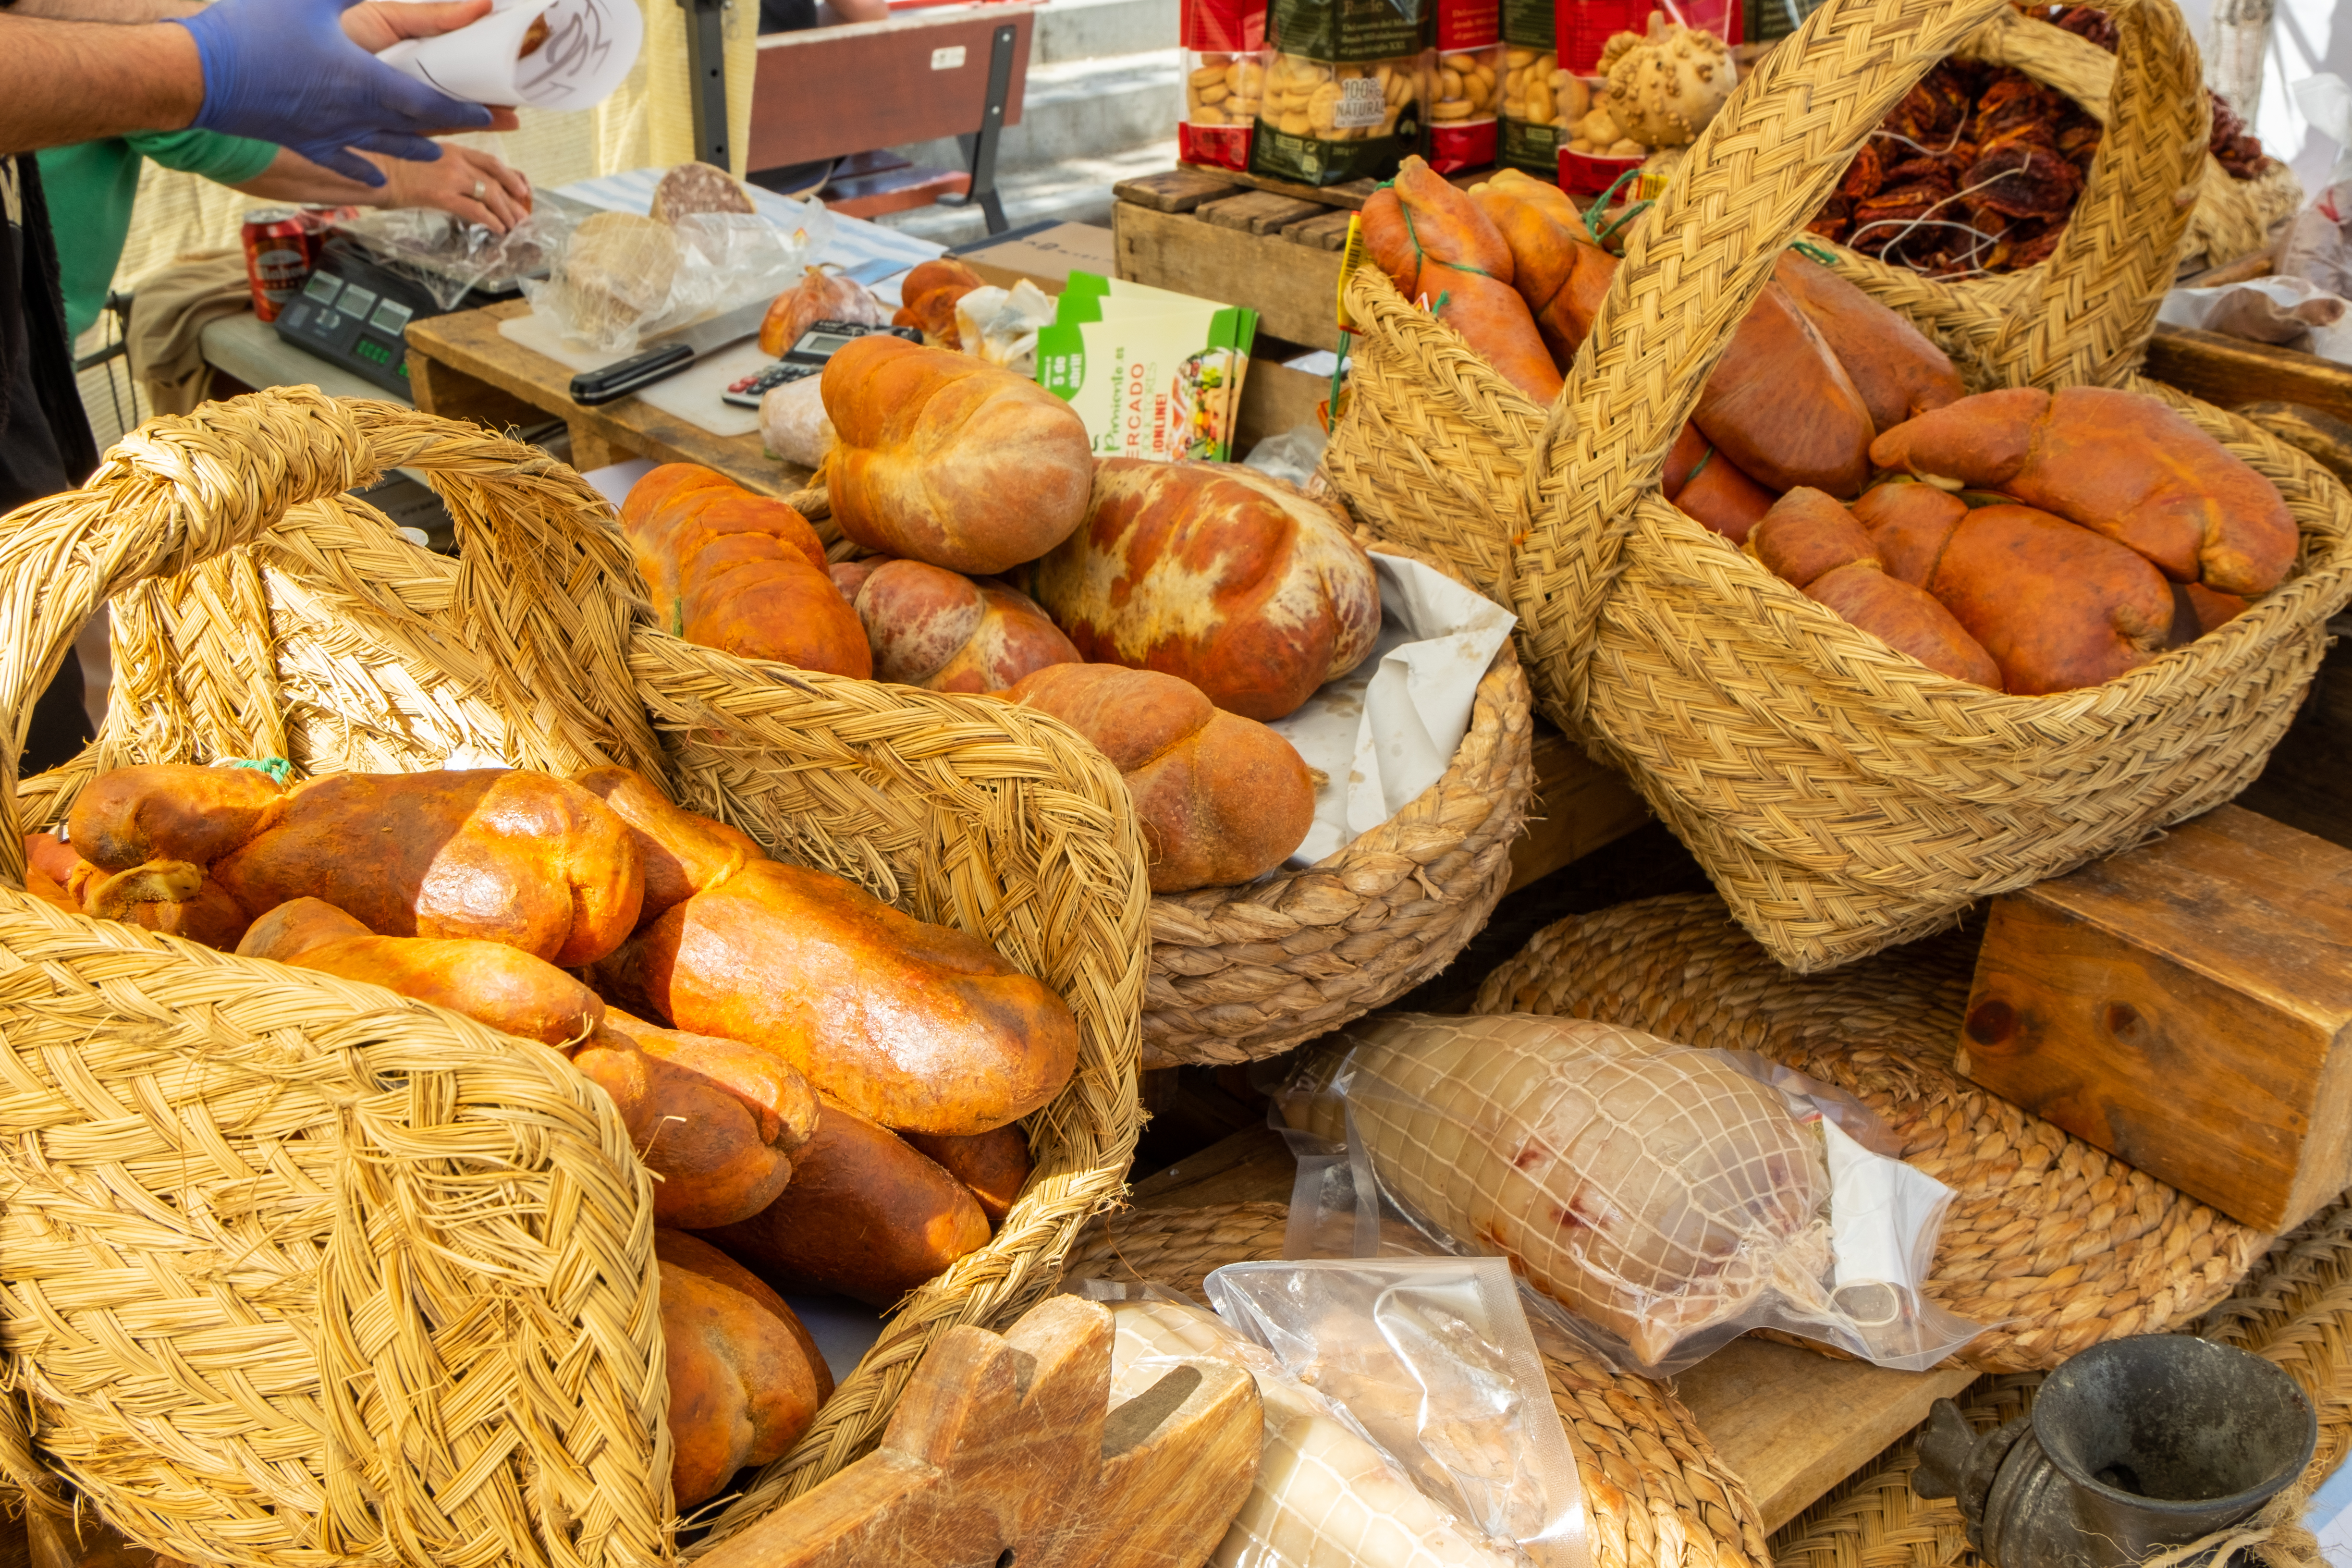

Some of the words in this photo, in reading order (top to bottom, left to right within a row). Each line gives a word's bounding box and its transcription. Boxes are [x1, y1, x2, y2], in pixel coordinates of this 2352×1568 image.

[1345, 80, 1382, 98] 100%
[1336, 101, 1384, 117] NATURAL
[1055, 356, 1066, 373] de
[1126, 363, 1144, 458] ERCADO
